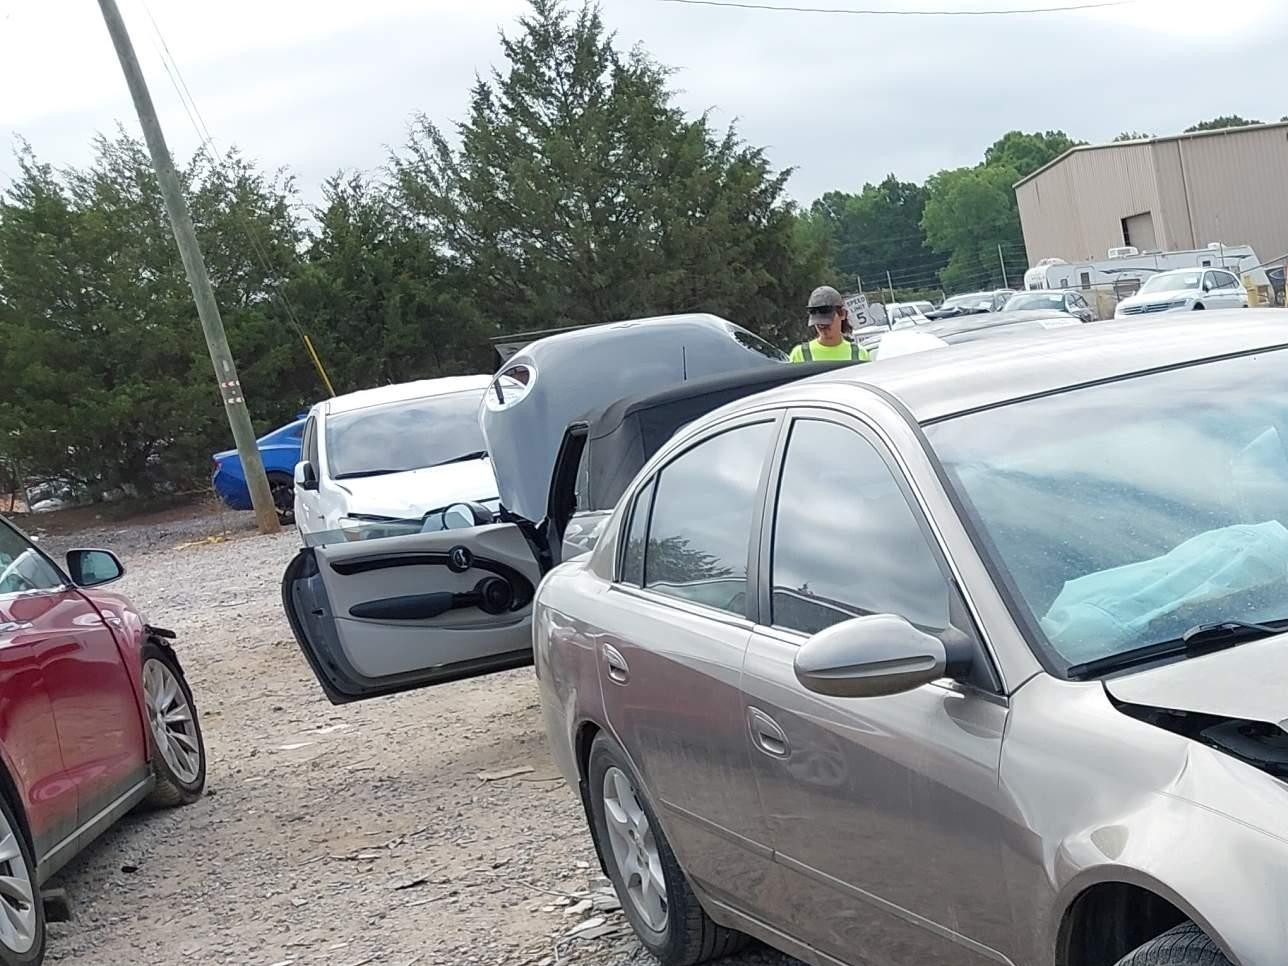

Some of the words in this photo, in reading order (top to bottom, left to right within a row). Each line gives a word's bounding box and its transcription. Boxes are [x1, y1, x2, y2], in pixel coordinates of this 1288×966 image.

[846, 296, 866, 306] SPEED
[850, 303, 866, 313] LIMIT
[856, 312, 867, 325] 5
